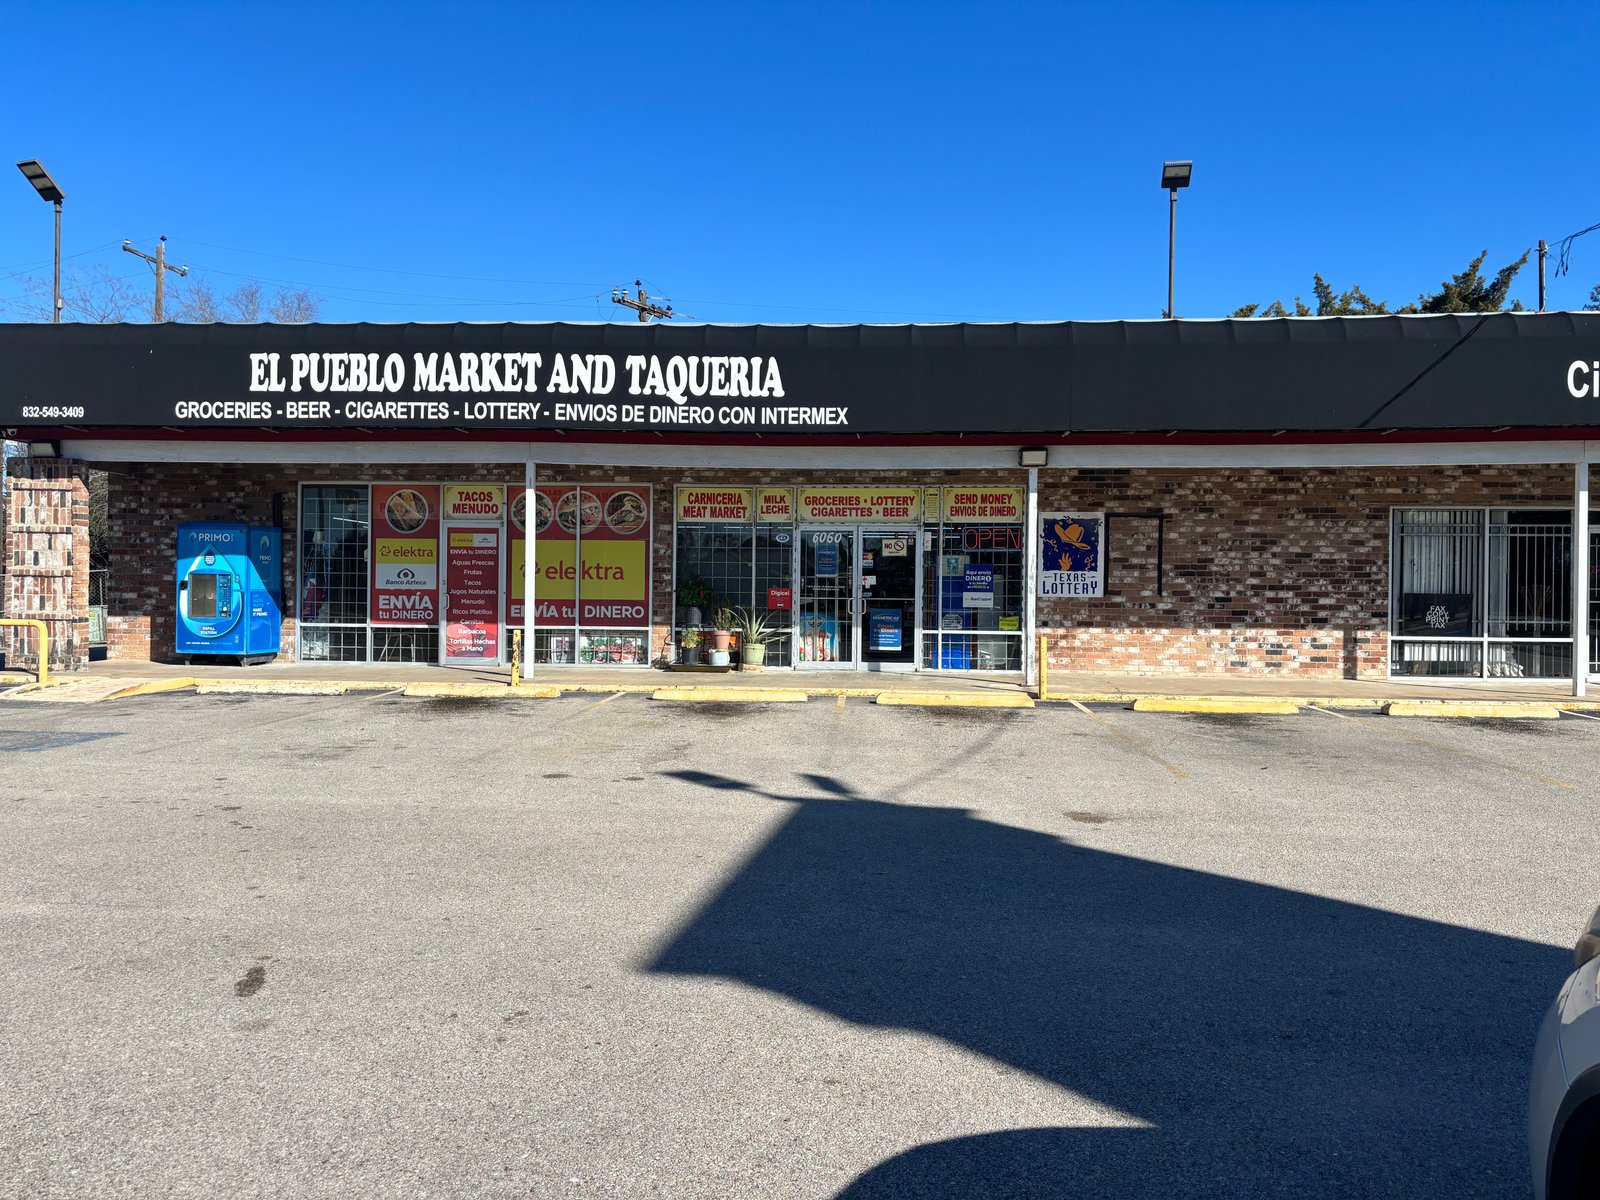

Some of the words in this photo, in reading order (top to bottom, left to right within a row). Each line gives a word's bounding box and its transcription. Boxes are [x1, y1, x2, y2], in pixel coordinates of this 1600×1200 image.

[249, 353, 286, 392] EL
[291, 353, 405, 392] PUEBLO
[413, 352, 542, 393] MARKET
[547, 353, 615, 394] AND
[626, 355, 785, 405] TAQUERIA
[1567, 360, 1600, 398] Ci
[22, 406, 85, 418] 832-549-3409
[175, 401, 272, 419] GROCERIES
[287, 401, 331, 419] BEER
[345, 401, 449, 420] CIGARETTES
[465, 402, 541, 420] LOTTERY
[555, 403, 617, 422] ENVIOS
[622, 405, 644, 422] DE
[650, 406, 714, 424] DINERO
[719, 407, 755, 425] CON
[761, 407, 848, 425] INTERMEX
[458, 491, 493, 502] TACOS
[687, 492, 743, 505] CARNICERIA
[763, 495, 786, 505] MILK
[804, 496, 861, 506] GROCERIES
[870, 496, 915, 506] LOTTERY
[954, 493, 979, 504] SEND
[980, 494, 1013, 505] MONEY
[452, 503, 499, 514] MENUDO
[683, 506, 708, 518] MEAT
[709, 506, 747, 519] MARKET
[760, 505, 790, 515] LECHE
[811, 507, 873, 517] CIGARETTES
[882, 507, 909, 517] BEER
[950, 506, 977, 517] ENVIOS
[978, 506, 988, 517] DE
[989, 506, 1017, 517] DINERO
[198, 533, 230, 542] PRIMO
[812, 531, 842, 543] 6060
[965, 528, 1021, 550] OPEN
[393, 546, 433, 558] elektra
[545, 560, 625, 580] elektra
[1053, 573, 1086, 582] TEXAS
[1042, 581, 1098, 594] LOTTERY
[379, 592, 434, 609] ENVÍA
[379, 610, 390, 619] tu
[392, 610, 434, 619] DINERO
[511, 602, 559, 618] EVÍA
[562, 605, 576, 618] tu
[584, 605, 645, 618] DINERO
